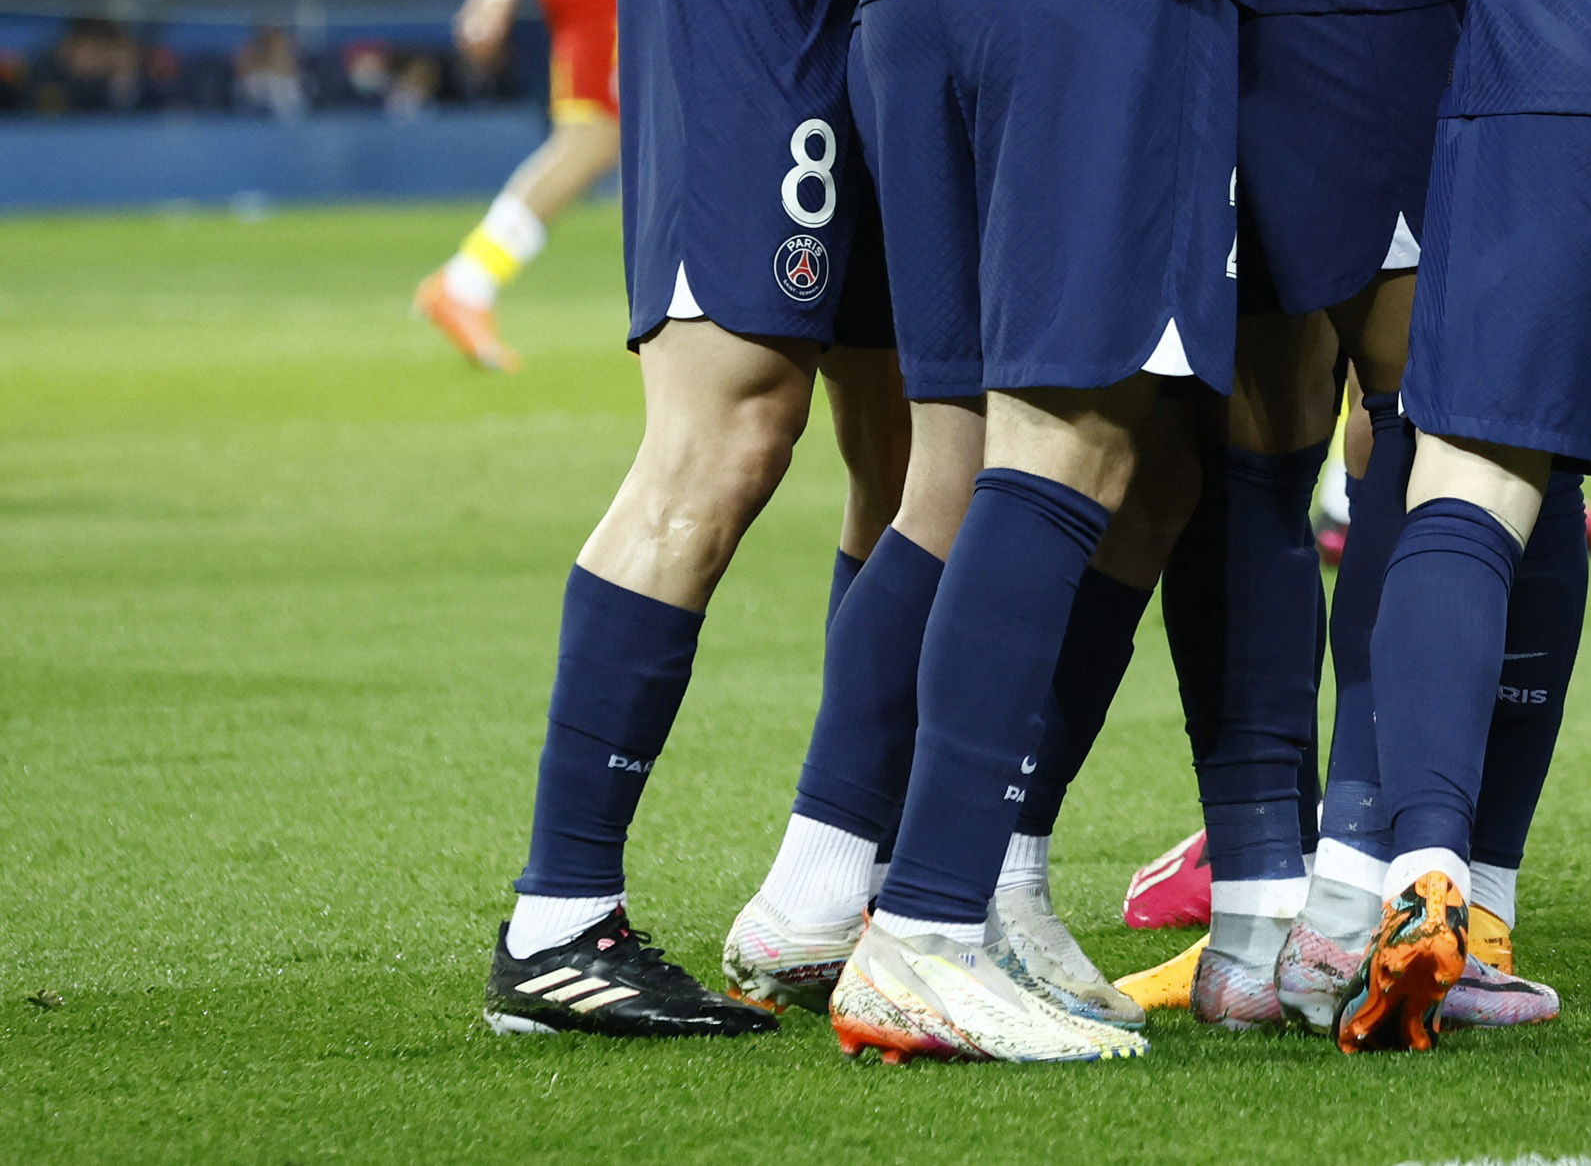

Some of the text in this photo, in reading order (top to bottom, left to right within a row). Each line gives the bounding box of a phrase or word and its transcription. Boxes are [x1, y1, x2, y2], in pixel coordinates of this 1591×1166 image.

[781, 118, 837, 229] 8
[786, 238, 824, 258] PARIS
[1498, 684, 1548, 704] RIS
